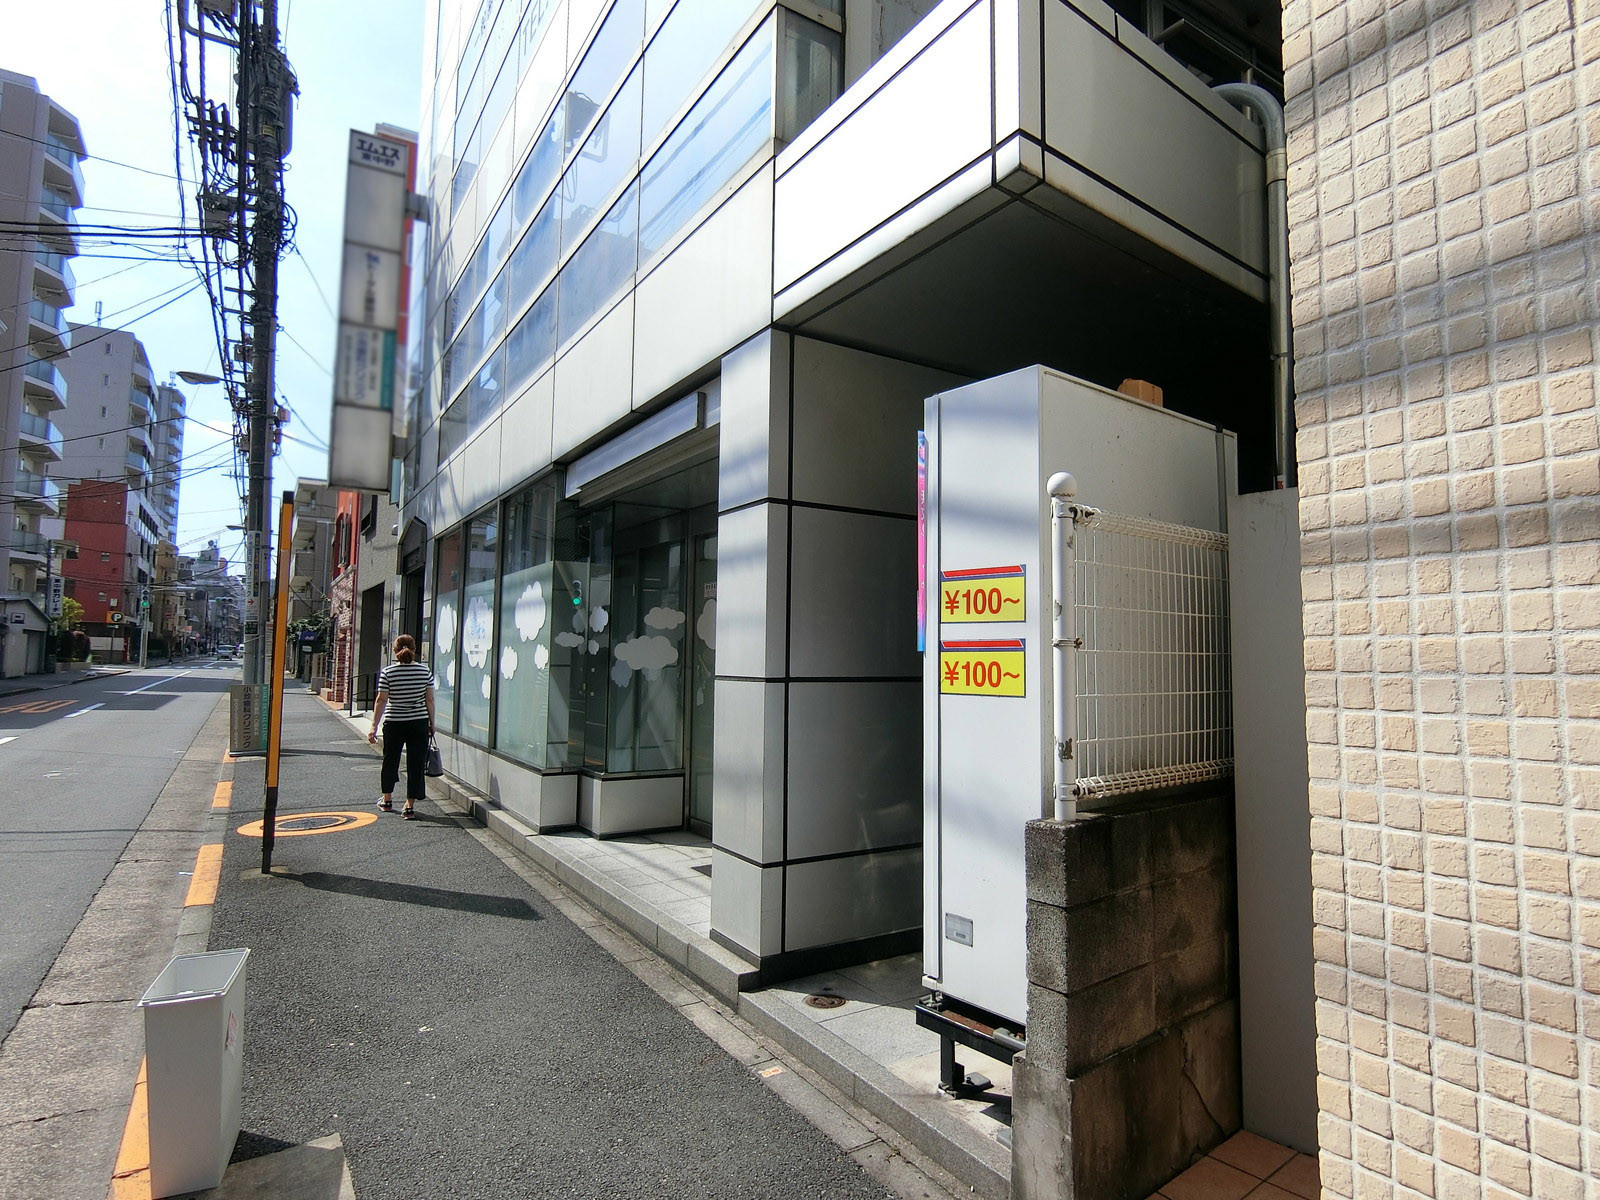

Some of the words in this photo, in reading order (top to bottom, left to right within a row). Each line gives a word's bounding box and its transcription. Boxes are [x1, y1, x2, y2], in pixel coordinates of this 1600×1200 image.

[356, 138, 400, 160] エムエス
[361, 152, 396, 168] 東中野
[944, 587, 1020, 615] ¥100~
[114, 613, 122, 622] P
[944, 660, 1020, 688] ¥100~
